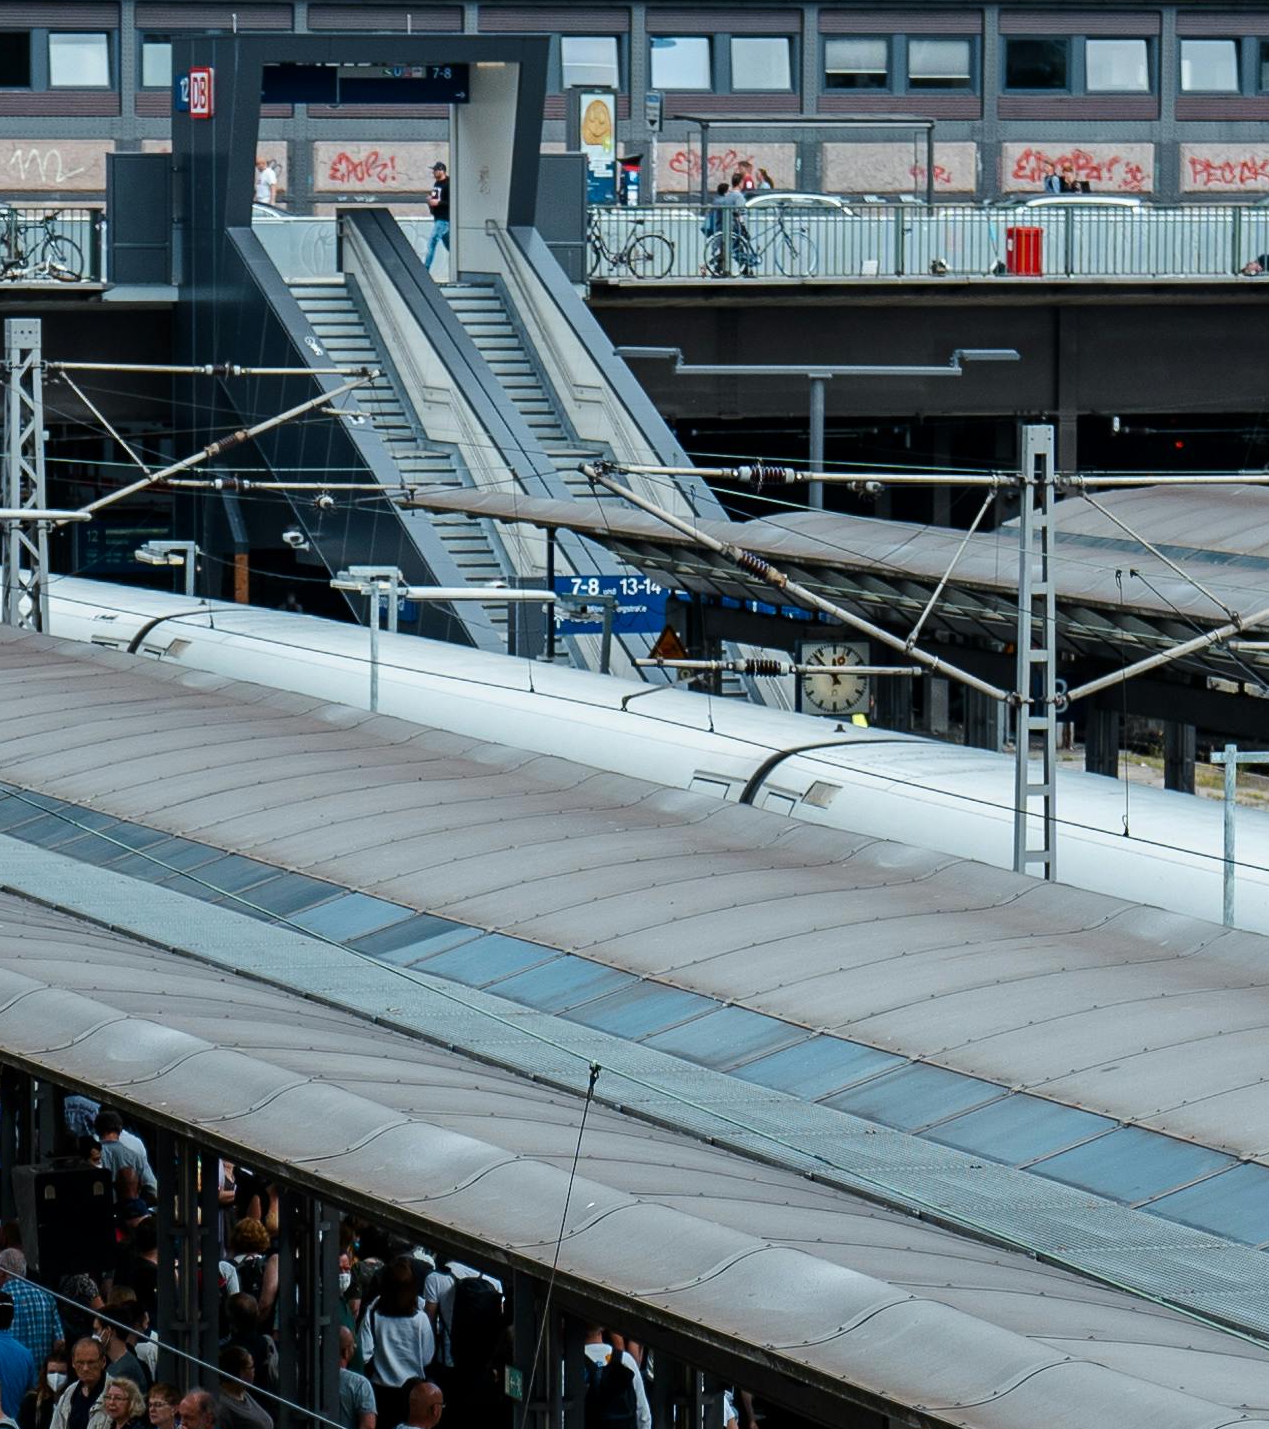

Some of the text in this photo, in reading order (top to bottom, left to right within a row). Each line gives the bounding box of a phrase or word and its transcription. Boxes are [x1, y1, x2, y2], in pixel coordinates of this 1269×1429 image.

[432, 68, 452, 79] 7-8
[570, 577, 600, 596] 7-8
[619, 577, 662, 596] 13-14
